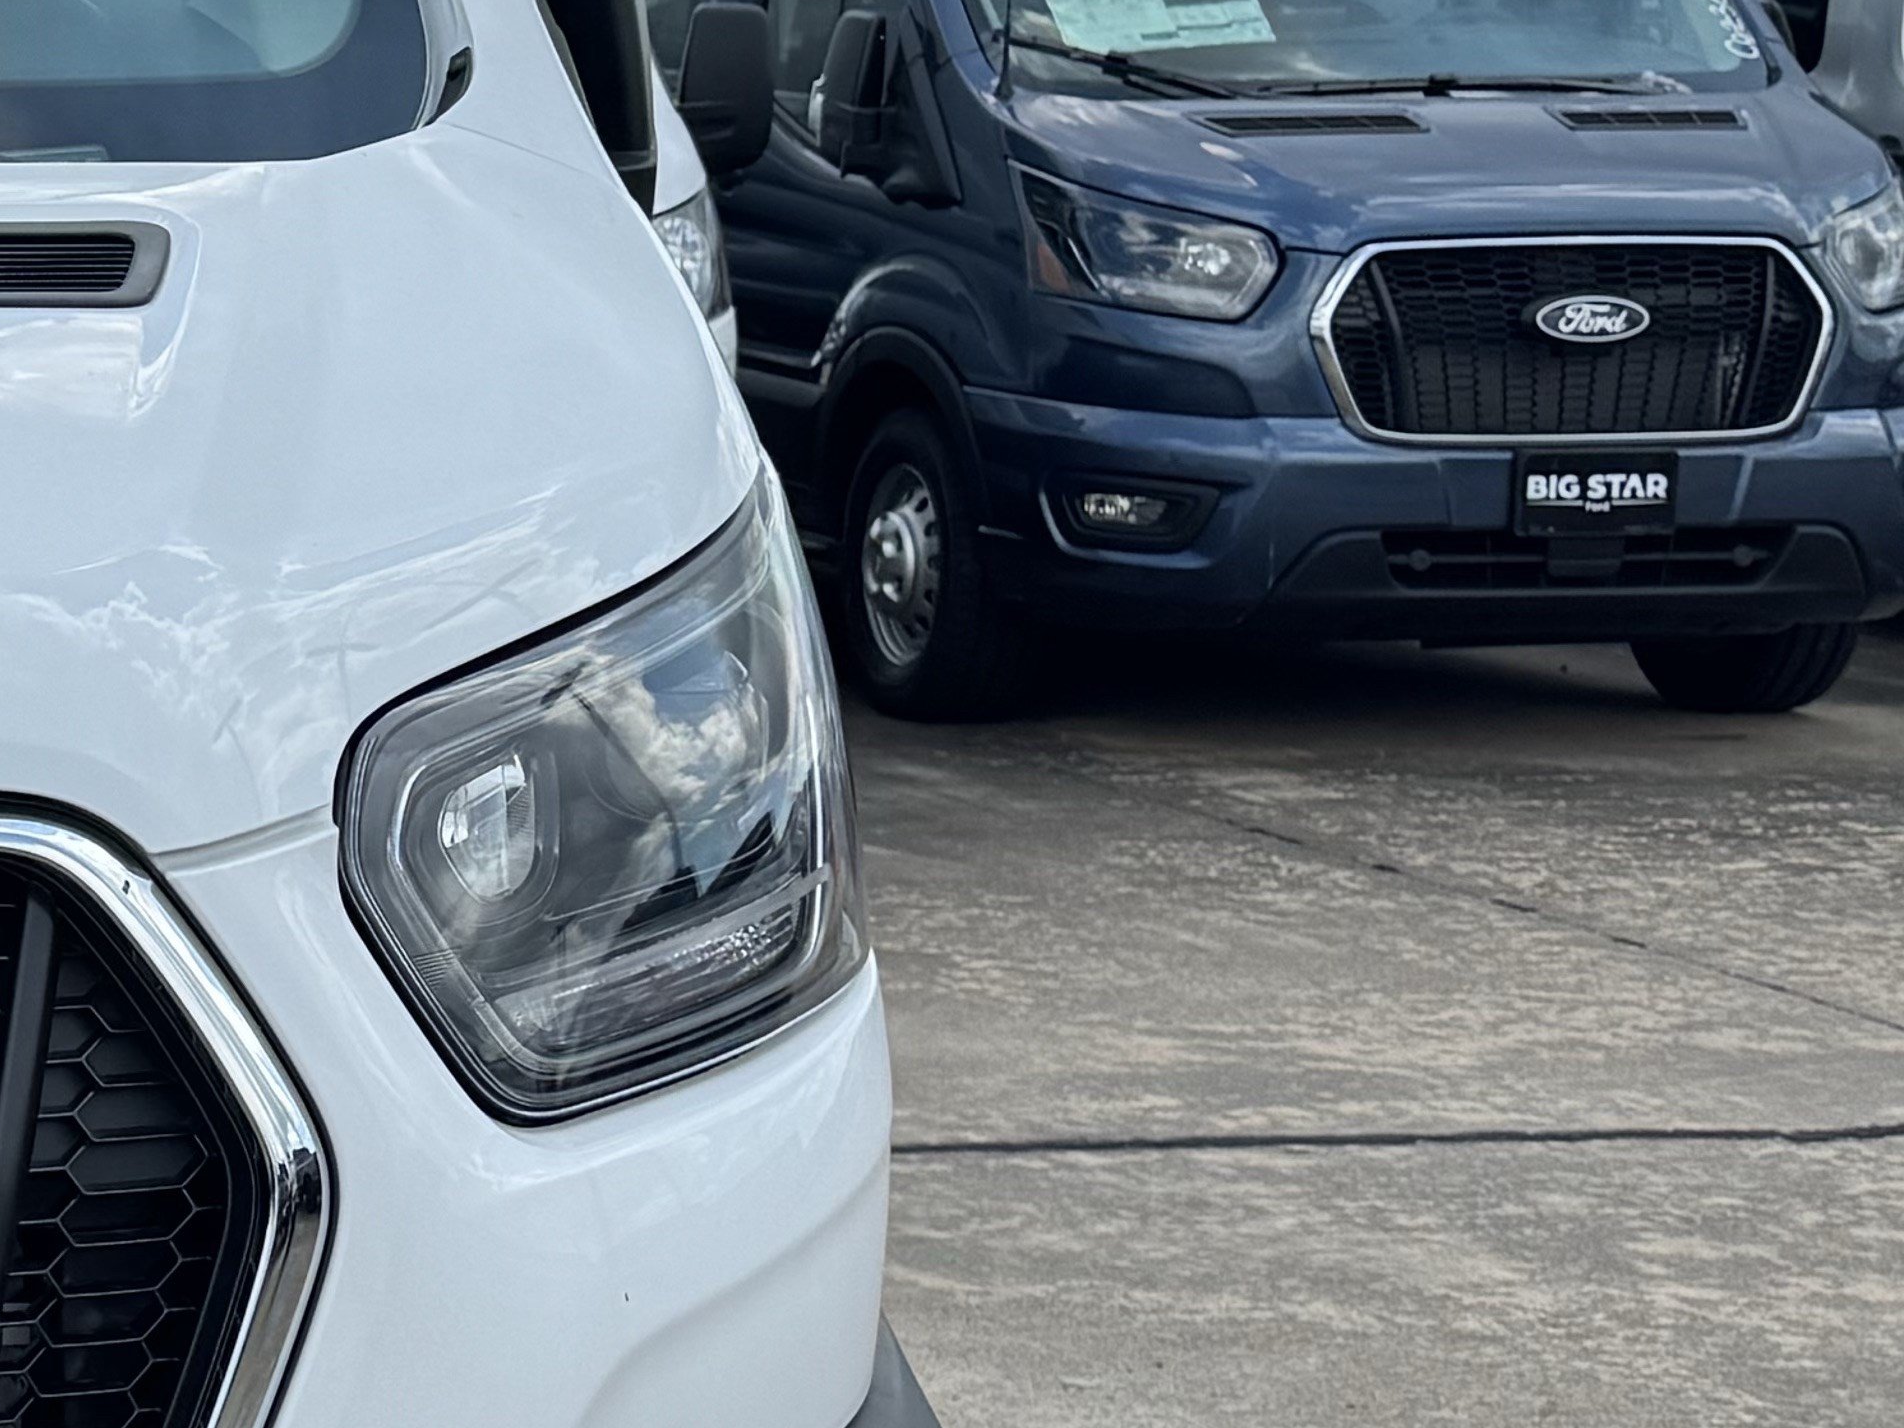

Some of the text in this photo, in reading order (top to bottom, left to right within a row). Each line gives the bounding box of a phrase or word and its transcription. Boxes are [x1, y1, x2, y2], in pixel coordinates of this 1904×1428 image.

[1557, 303, 1628, 333] Ford
[1526, 473, 1668, 500] BIG STAR
